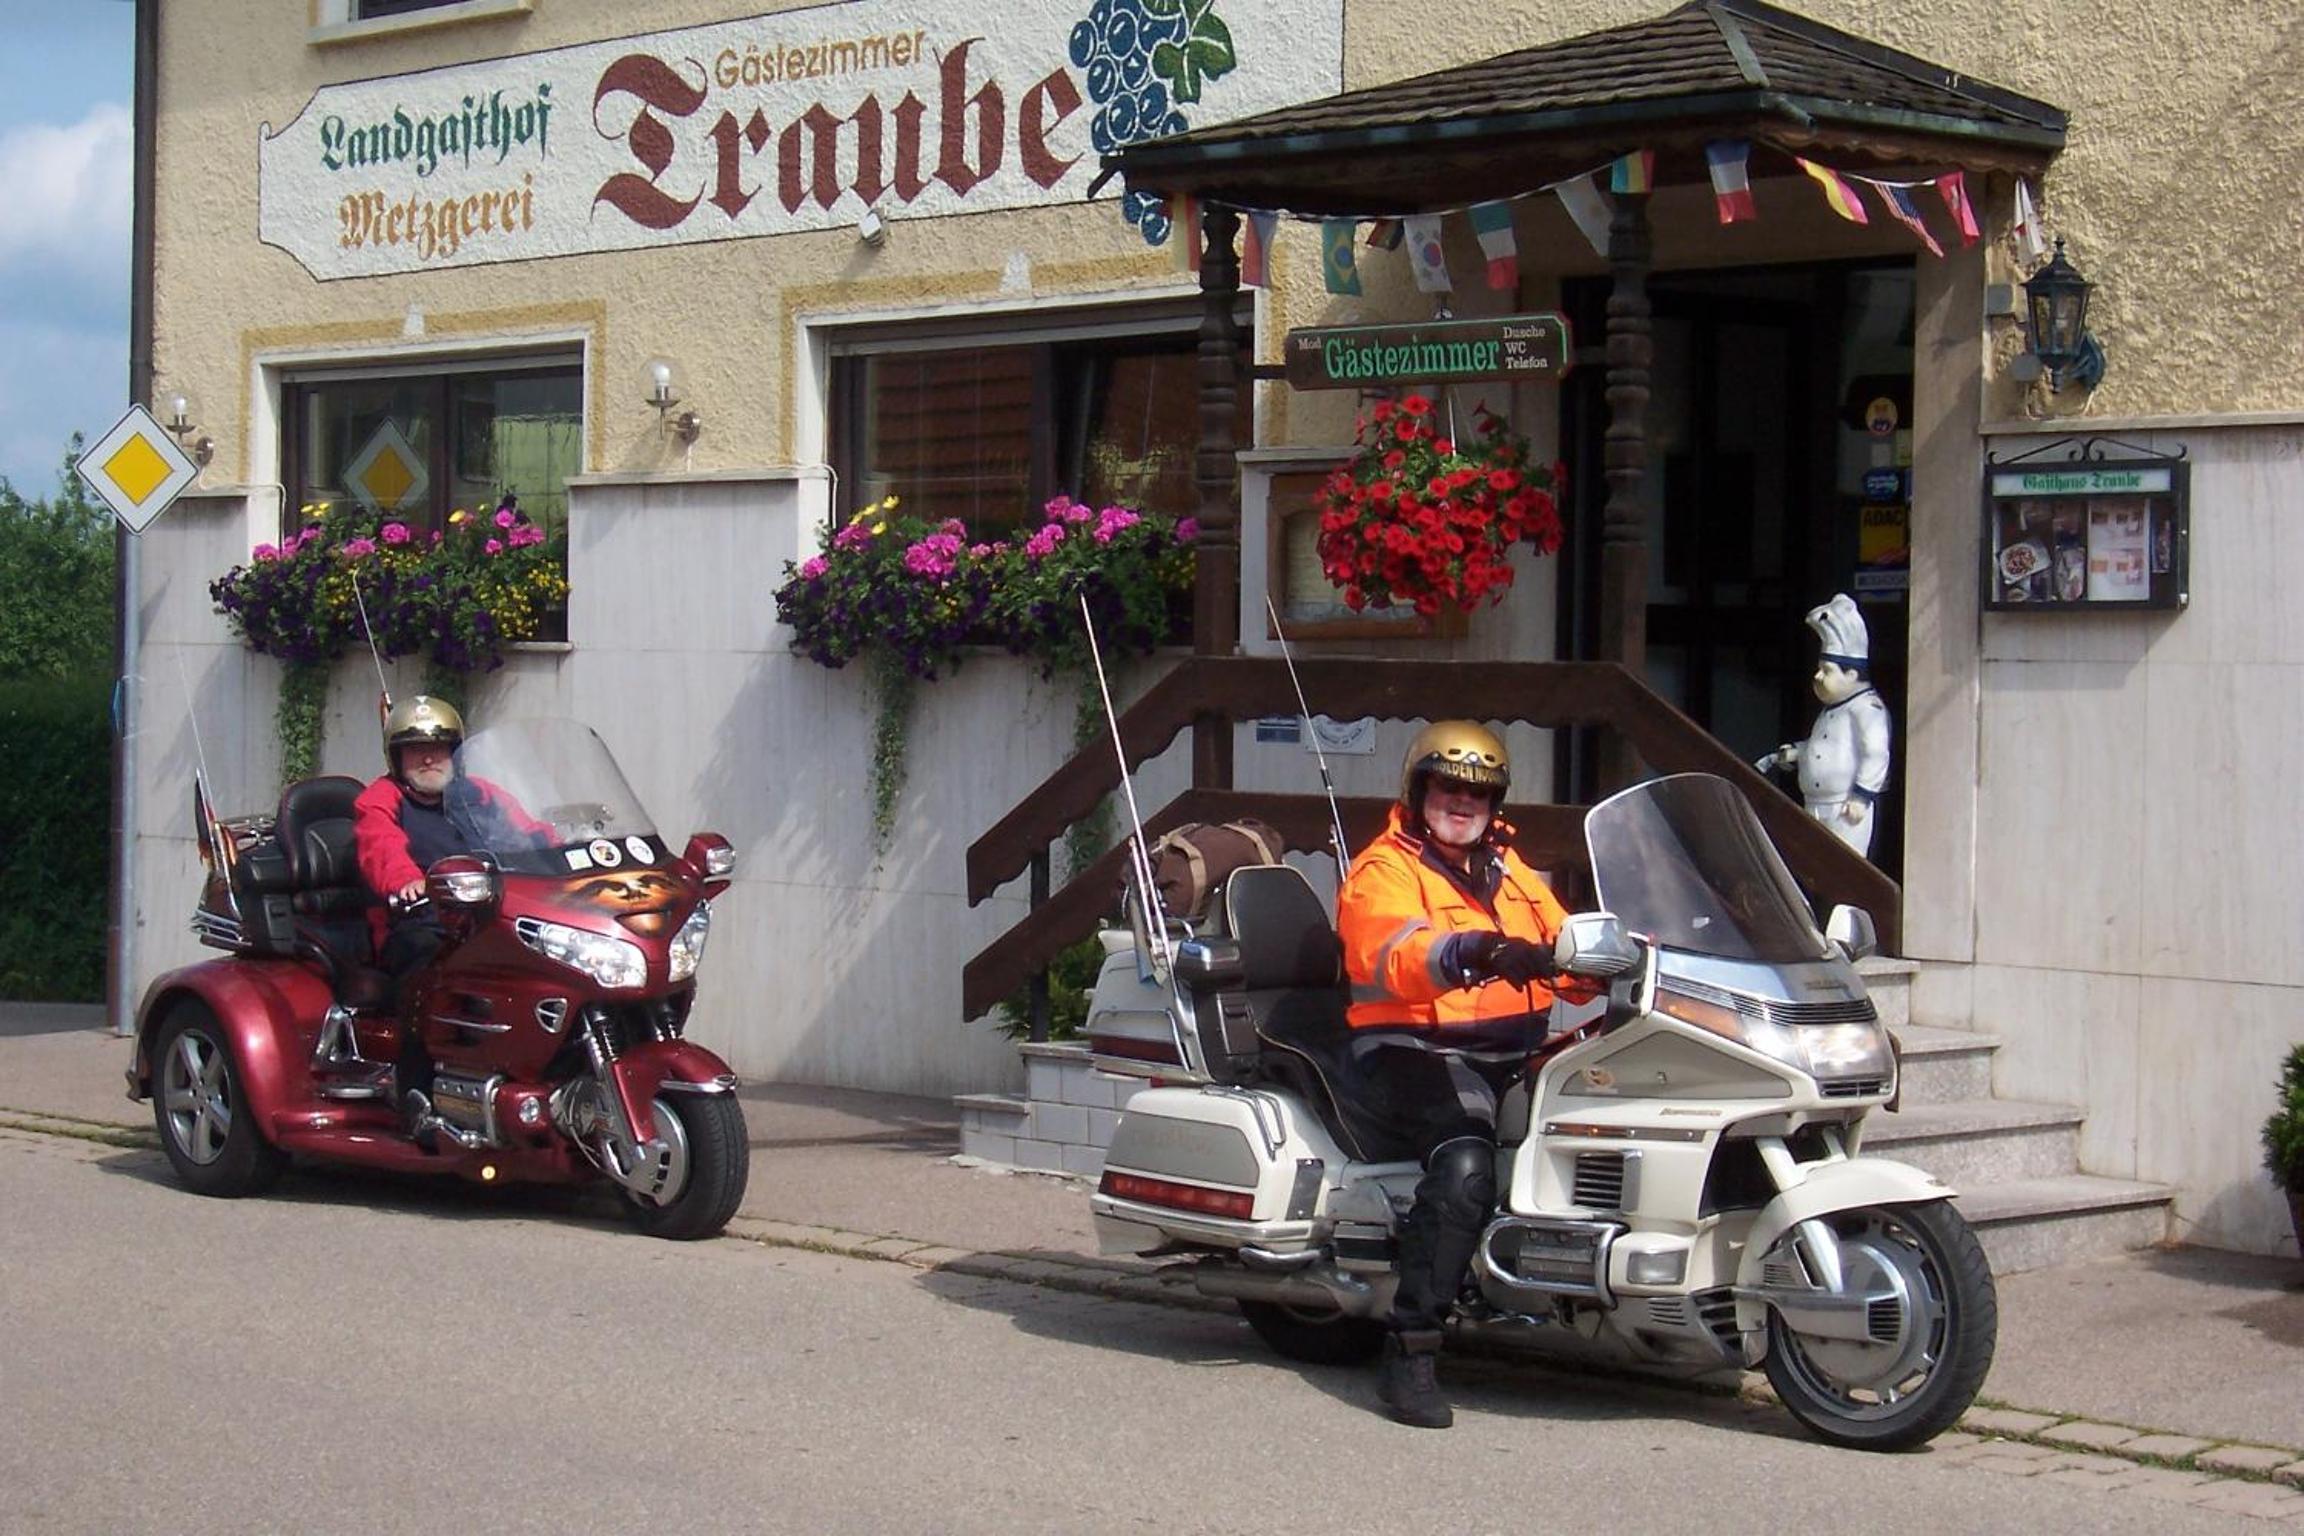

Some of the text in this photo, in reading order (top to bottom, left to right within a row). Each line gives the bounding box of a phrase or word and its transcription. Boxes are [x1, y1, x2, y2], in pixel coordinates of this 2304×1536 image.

[714, 28, 925, 89] Gästezimmer
[319, 81, 553, 178] Landgasthof
[590, 36, 1084, 229] Traube
[338, 173, 536, 261] Metzgerei
[1502, 325, 1546, 339] Dusche
[1504, 341, 1527, 355] WC
[1324, 334, 1500, 379] Gästezimmer
[1505, 355, 1549, 370] Telefon
[2091, 472, 2141, 488] Traube
